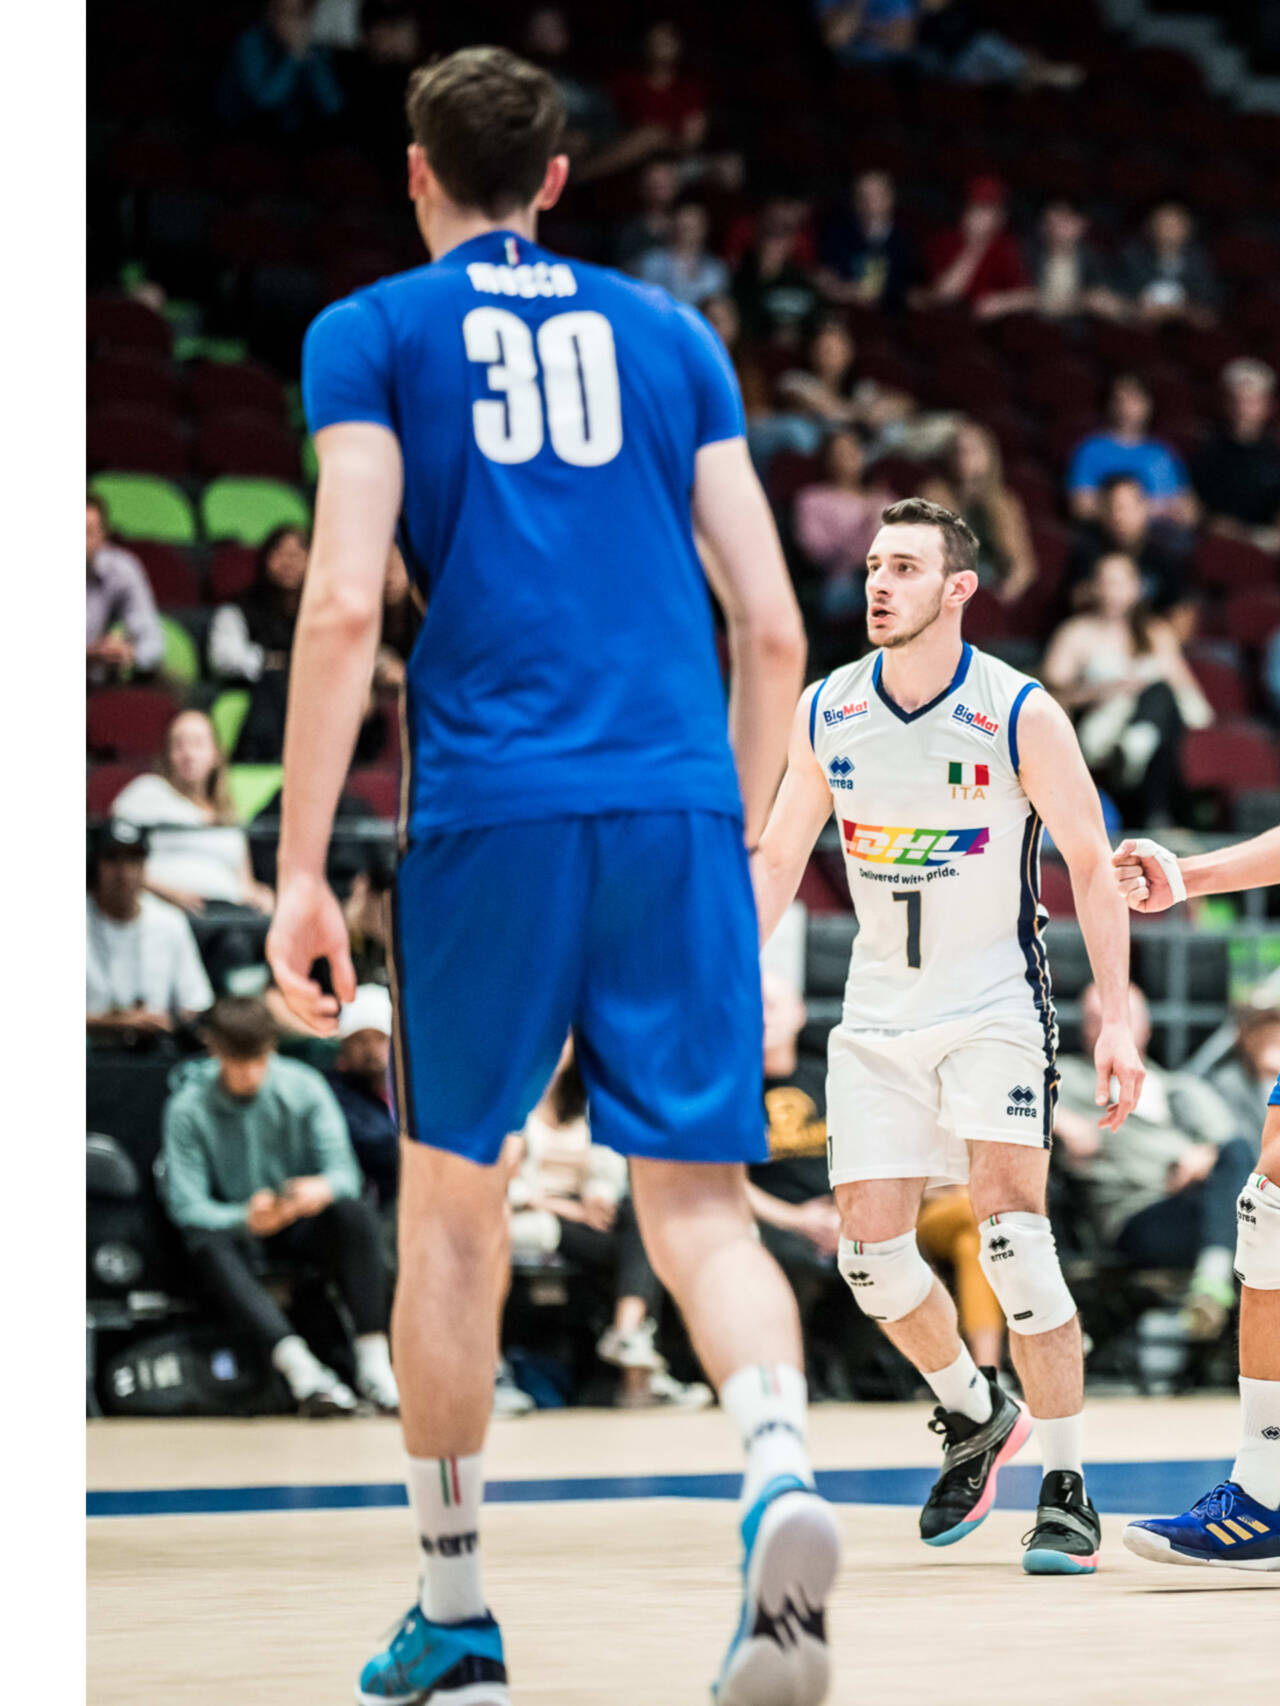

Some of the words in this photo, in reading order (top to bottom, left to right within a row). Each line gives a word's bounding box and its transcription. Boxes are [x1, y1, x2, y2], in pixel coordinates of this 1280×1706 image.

[462, 306, 623, 467] 30
[823, 701, 868, 723] BigMat
[953, 704, 999, 733] BigMat
[951, 786, 986, 801] ITA
[853, 829, 967, 862] DHL
[926, 867, 960, 882] pride.
